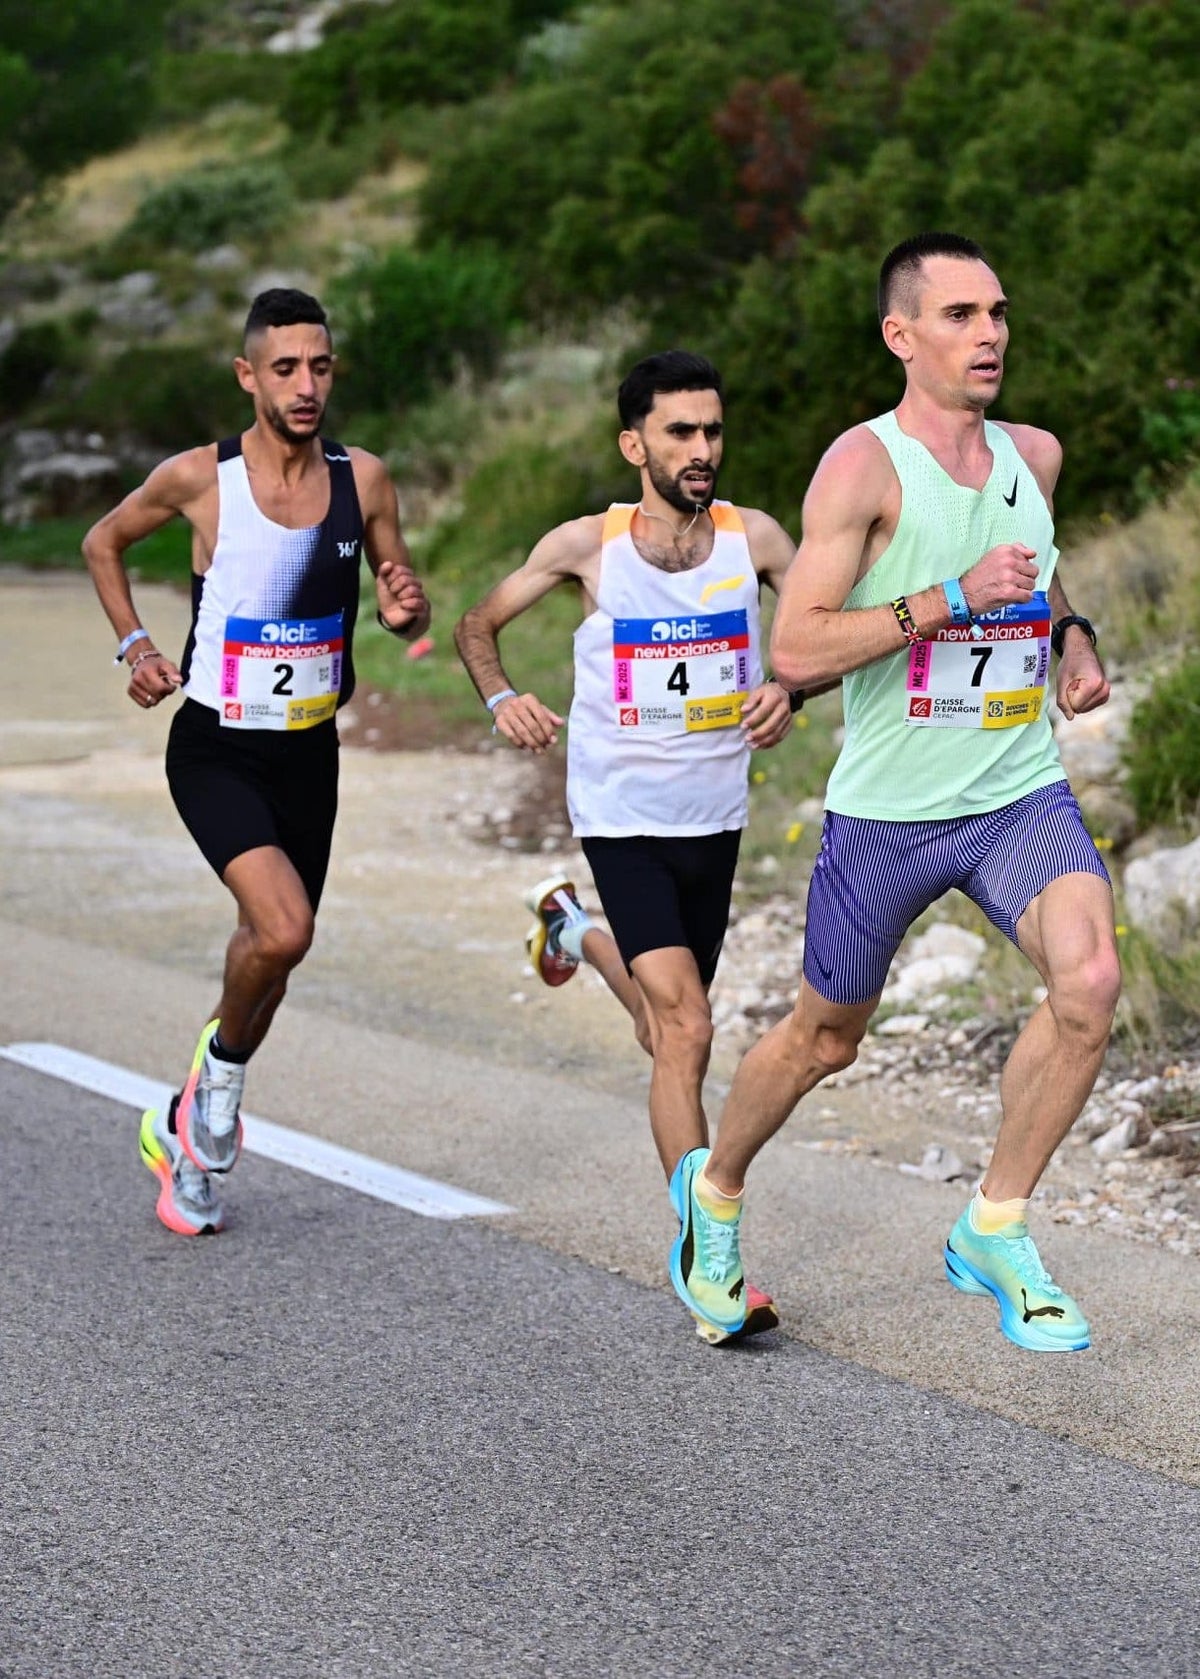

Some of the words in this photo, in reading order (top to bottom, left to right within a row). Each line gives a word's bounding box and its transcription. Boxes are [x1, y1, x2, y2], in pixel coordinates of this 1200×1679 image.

[671, 619, 697, 640] ici
[937, 628, 972, 641] new
[974, 625, 1033, 641] alance
[242, 645, 274, 658] new
[275, 643, 330, 659] balance
[634, 647, 666, 658] new
[668, 640, 729, 657] balance
[916, 644, 927, 669] 2025
[618, 662, 628, 683] 2025
[738, 656, 746, 684] ELITES
[970, 646, 993, 687] 7
[1038, 646, 1047, 678] ELITES
[272, 663, 294, 696] 2
[667, 661, 690, 695] 4
[912, 671, 924, 688] MC
[618, 687, 628, 700] MC
[934, 698, 964, 706] CAISSE
[933, 705, 980, 713] D'EPARGNE
